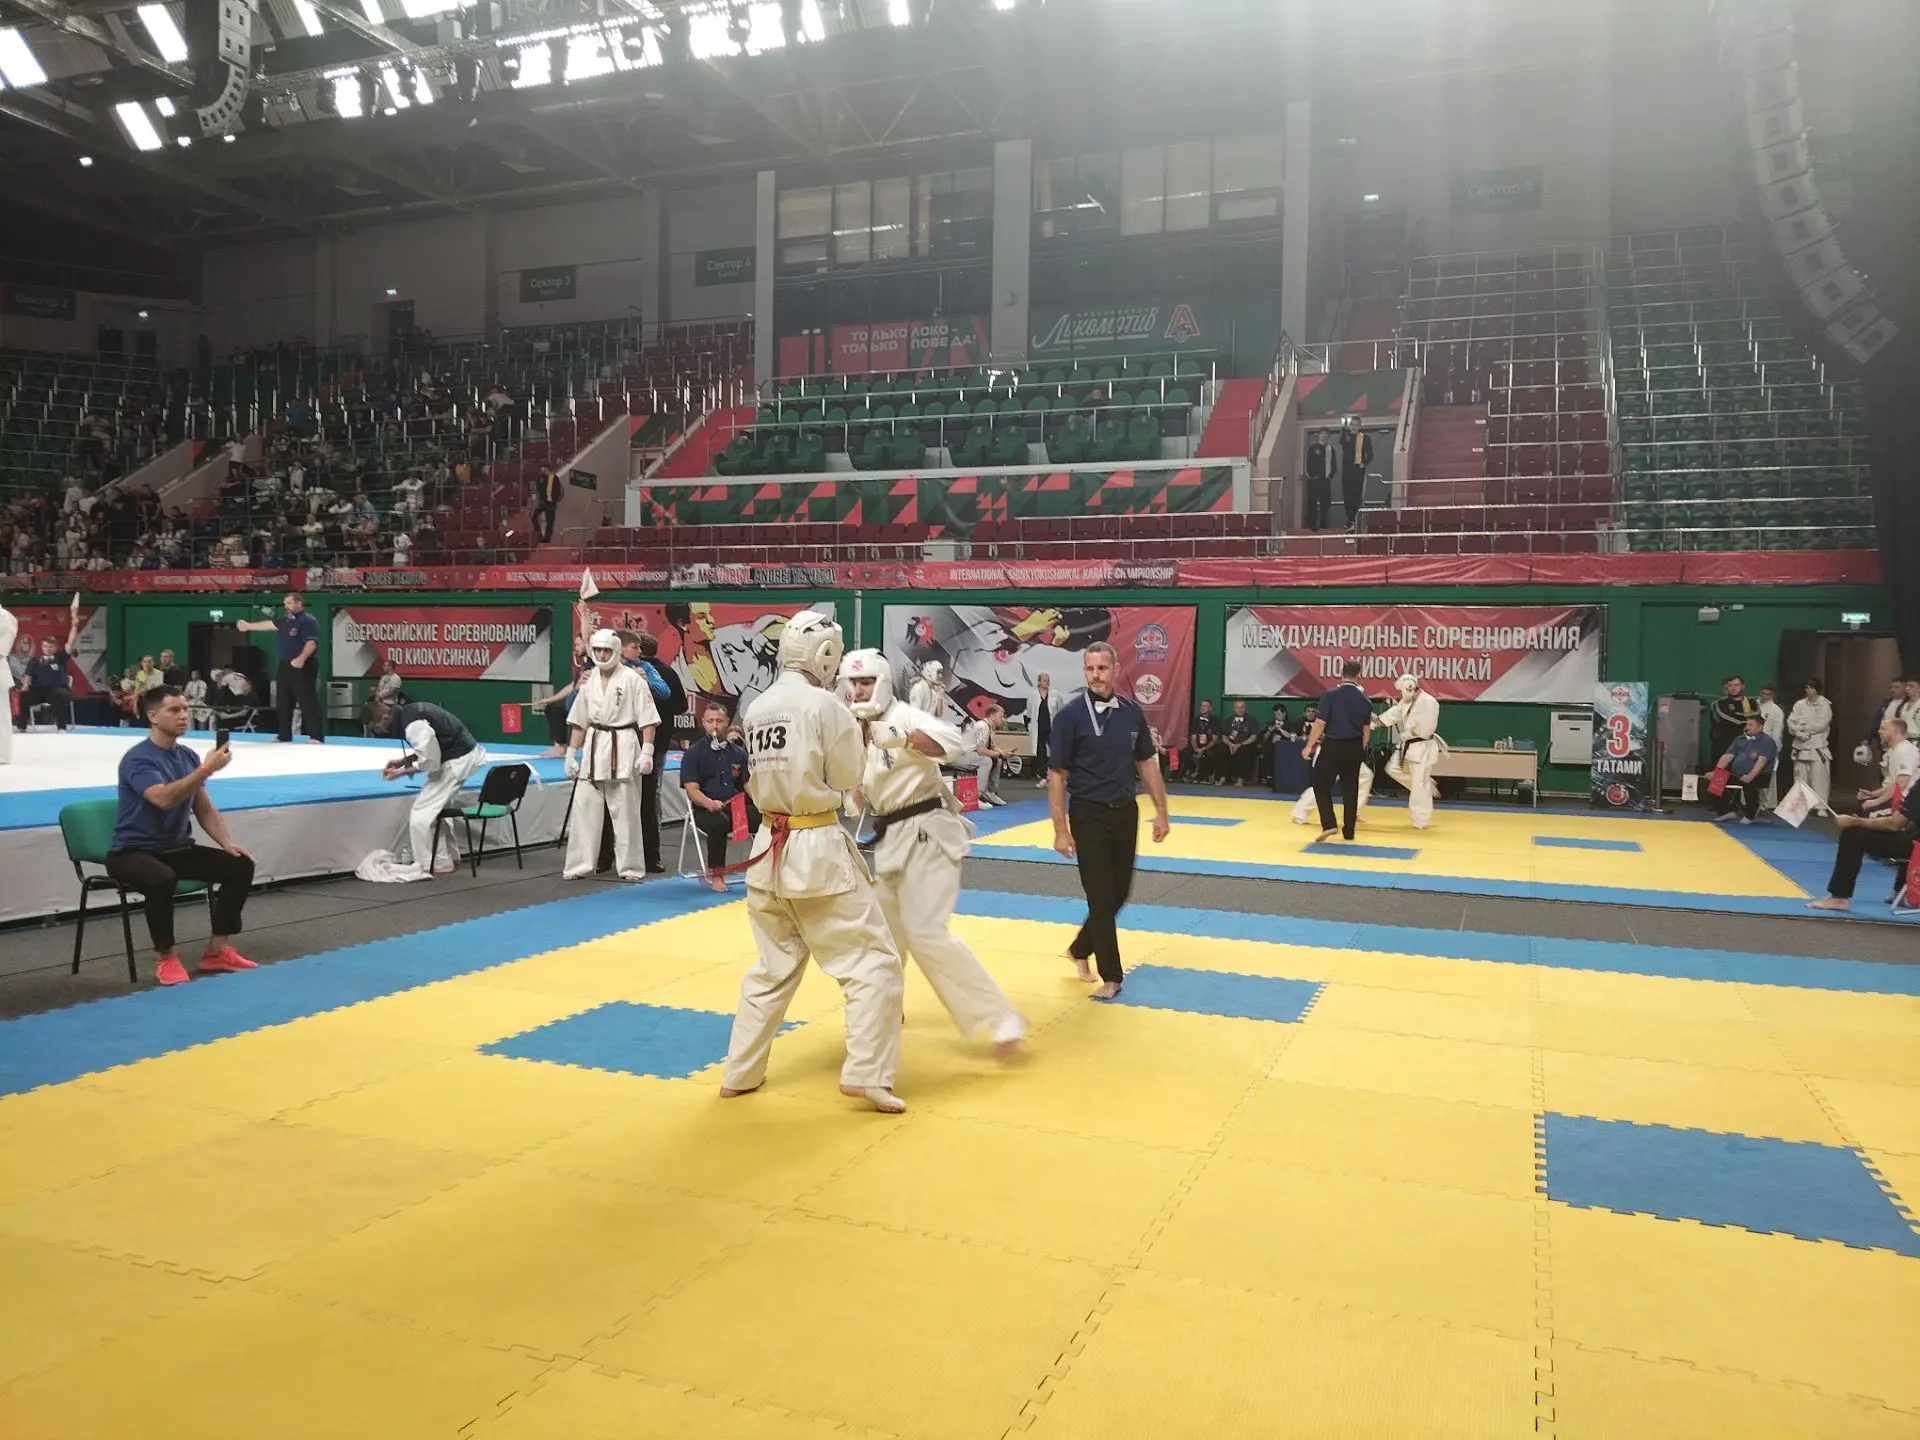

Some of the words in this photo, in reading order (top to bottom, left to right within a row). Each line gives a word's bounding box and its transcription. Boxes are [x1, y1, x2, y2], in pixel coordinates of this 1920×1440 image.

[706, 260, 743, 271] Сектор
[530, 278, 563, 289] Сектор
[850, 328, 908, 342] ТОЛЬКО
[911, 324, 948, 338] ЛОКО
[839, 340, 898, 354] ТОЛЬКО
[910, 334, 977, 350] ПОБЕДА!
[950, 568, 1005, 581] INTERNATIONAL
[1083, 567, 1113, 580] KARATE
[1114, 567, 1175, 580] CHAMPIONSHIP
[345, 620, 438, 643] ВСЕРОССИЙСКИЕ
[443, 623, 537, 644] СОРЕВНОВАНИЯ
[1241, 624, 1418, 651] МЕЖДУНАРОДНЫЕ
[1423, 625, 1581, 652] СОРЕВНОВАНИЯ
[387, 647, 402, 665] ПО
[405, 645, 490, 667] КИОКУСИНКАЙ
[1319, 655, 1343, 679] ПО
[1346, 652, 1492, 680] ИОКУСИНКАЙ
[1606, 712, 1632, 758] 3
[1596, 759, 1643, 775] ТАТАМИ
